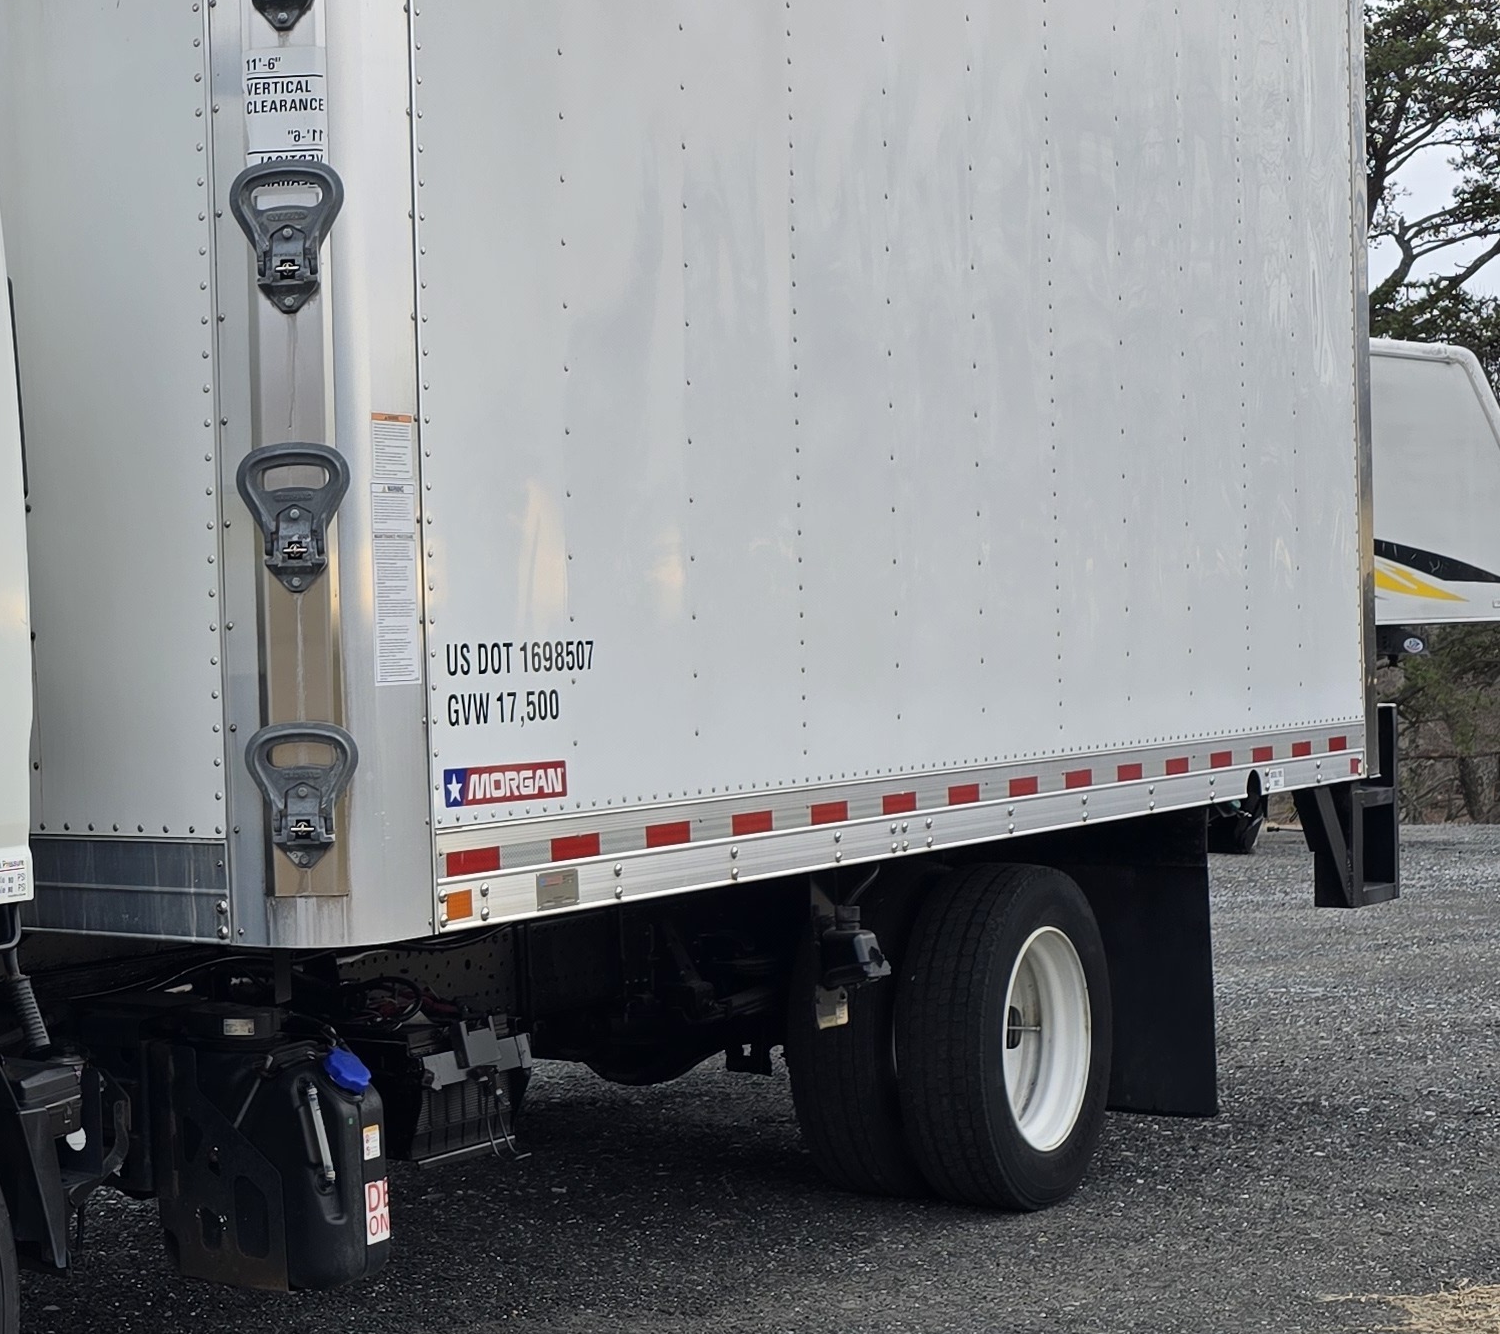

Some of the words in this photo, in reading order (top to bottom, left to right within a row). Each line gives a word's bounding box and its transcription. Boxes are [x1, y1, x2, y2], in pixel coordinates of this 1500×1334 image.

[246, 80, 312, 96] VERTICAL
[246, 98, 324, 115] CLEARANCE
[446, 643, 471, 676] US
[477, 642, 513, 675] DOT
[519, 640, 594, 673] 1698507
[447, 692, 490, 727] GVW
[496, 689, 560, 728] 17,500
[467, 767, 563, 801] MORGAN
